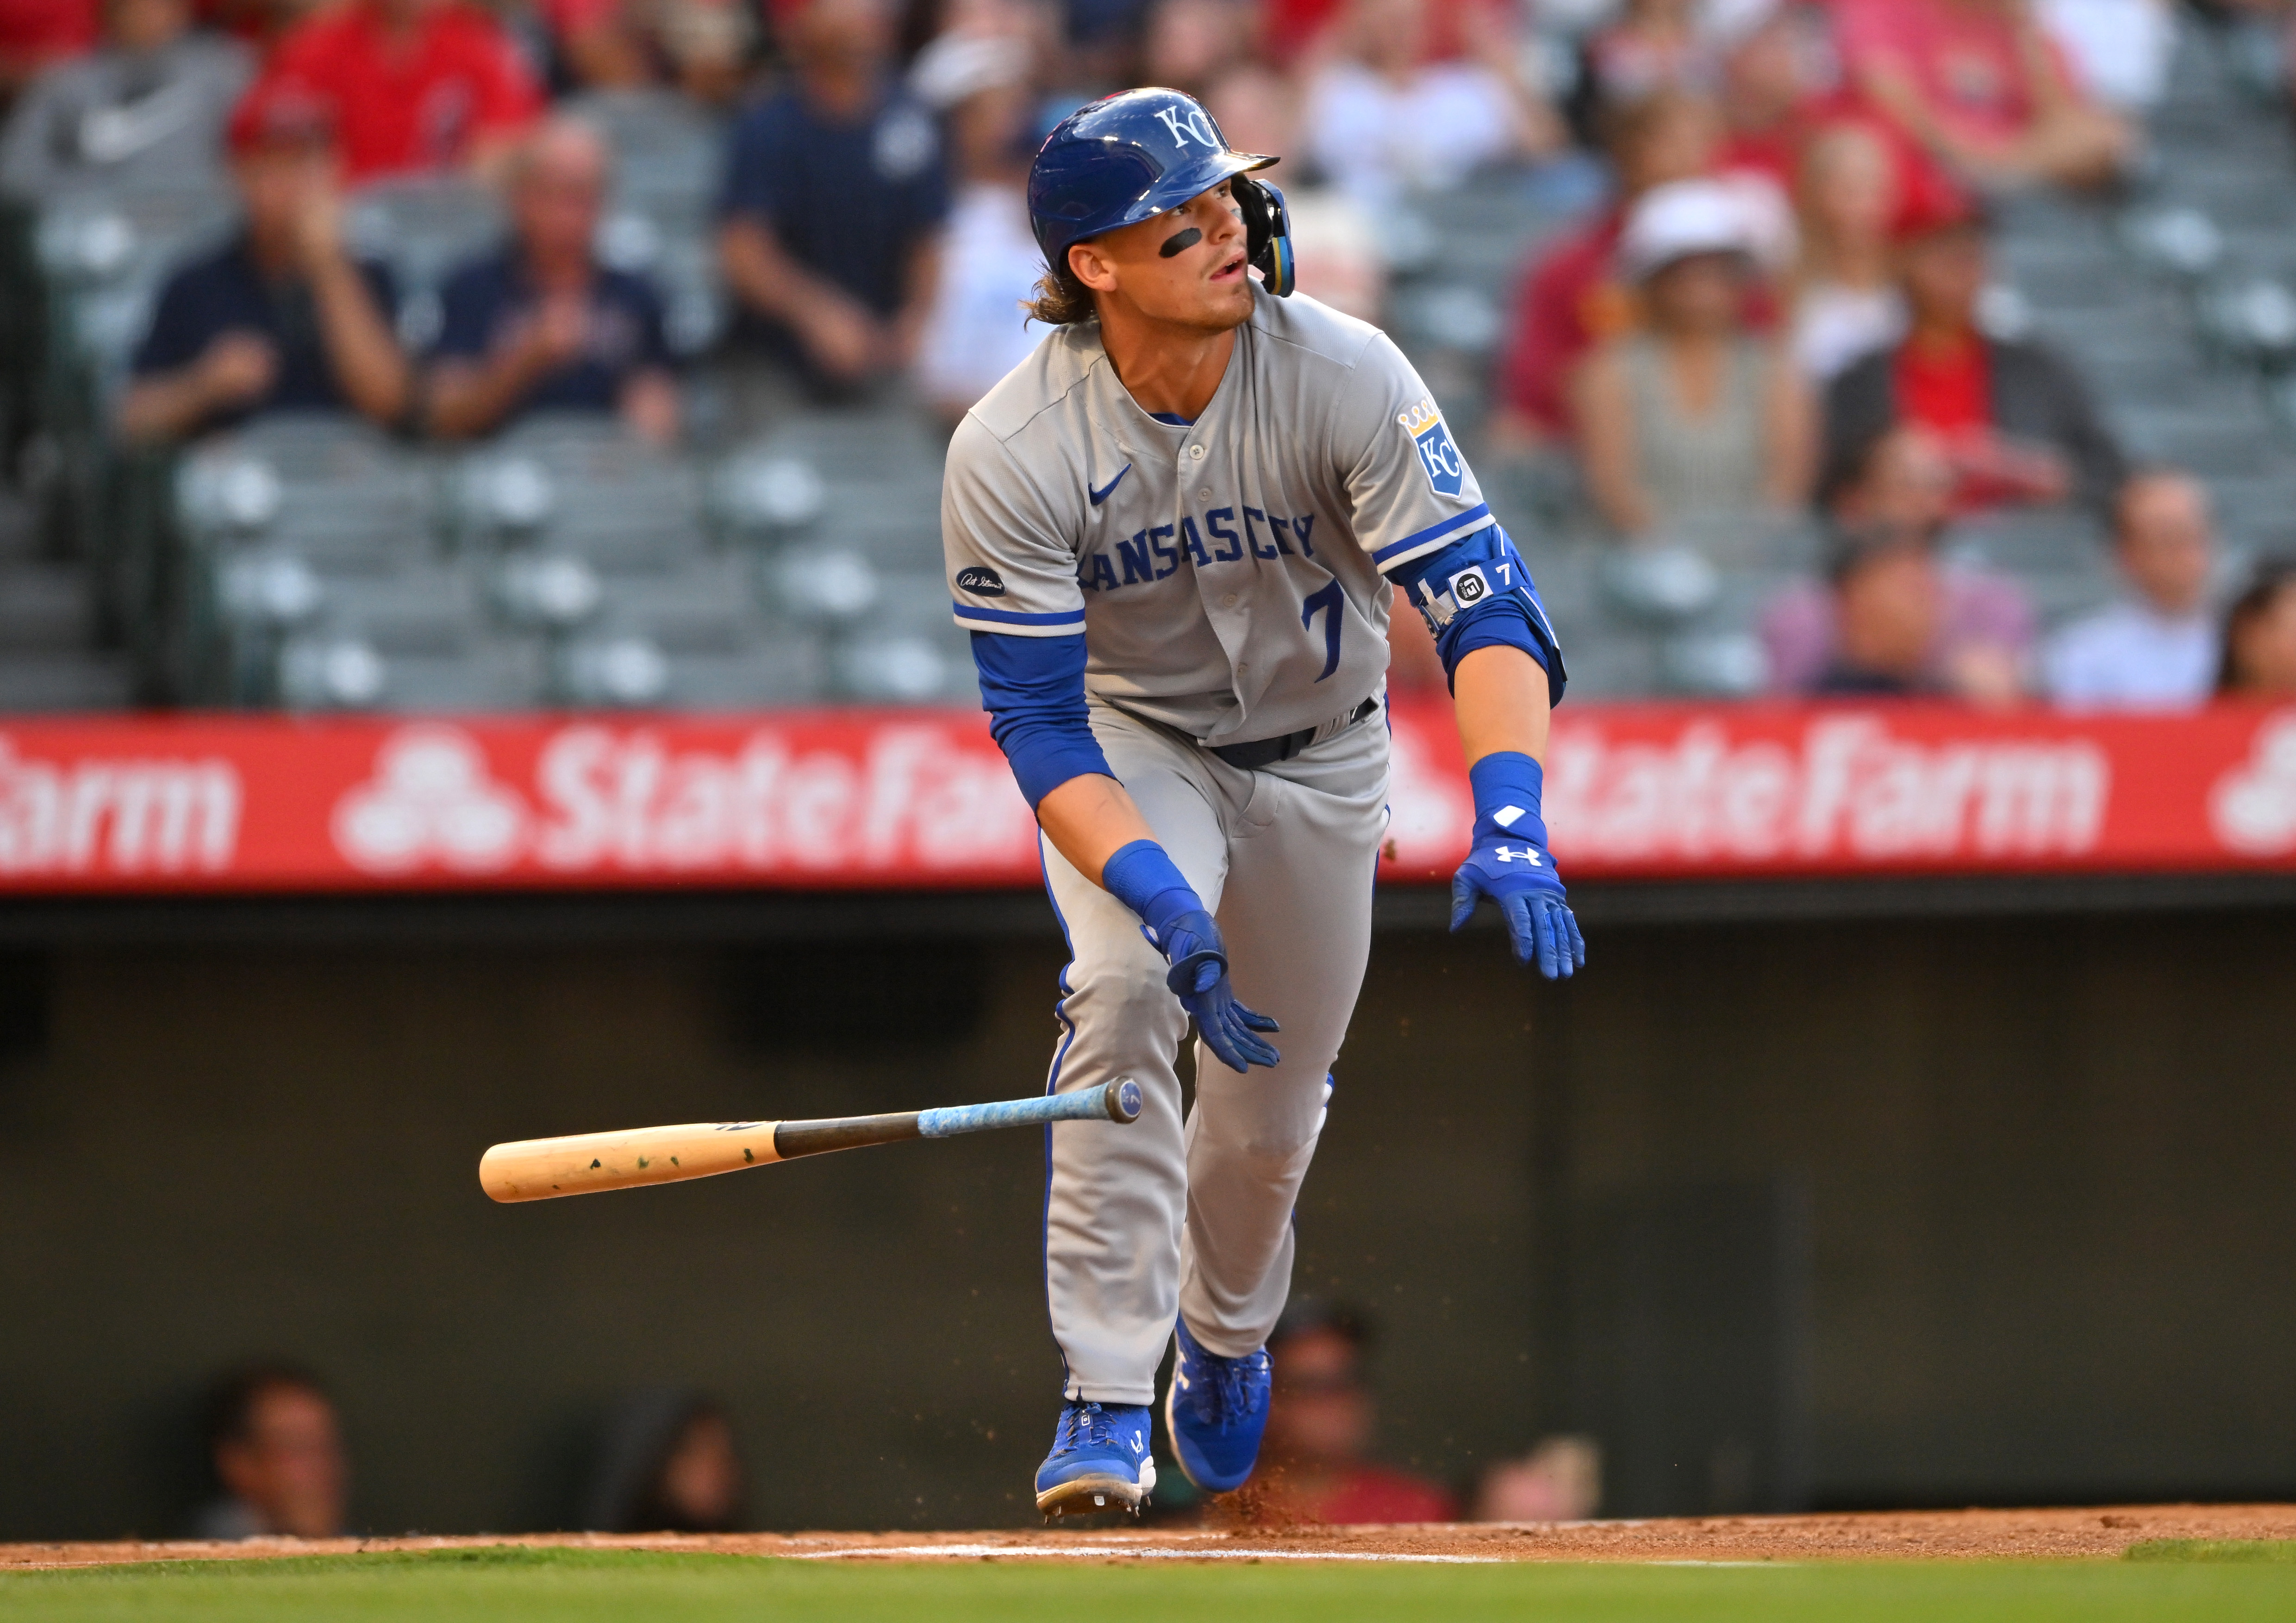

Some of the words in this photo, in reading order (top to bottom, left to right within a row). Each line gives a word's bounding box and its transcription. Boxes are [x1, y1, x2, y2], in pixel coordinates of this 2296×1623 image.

[1153, 106, 1216, 149] KC
[1420, 436, 1460, 478] KC
[1242, 505, 1315, 558] CTY
[1459, 583, 1470, 599] G-FORM
[1495, 563, 1510, 586] 7
[1301, 577, 1344, 684] 7
[0, 736, 243, 870] arm
[1539, 727, 1791, 862] tate
